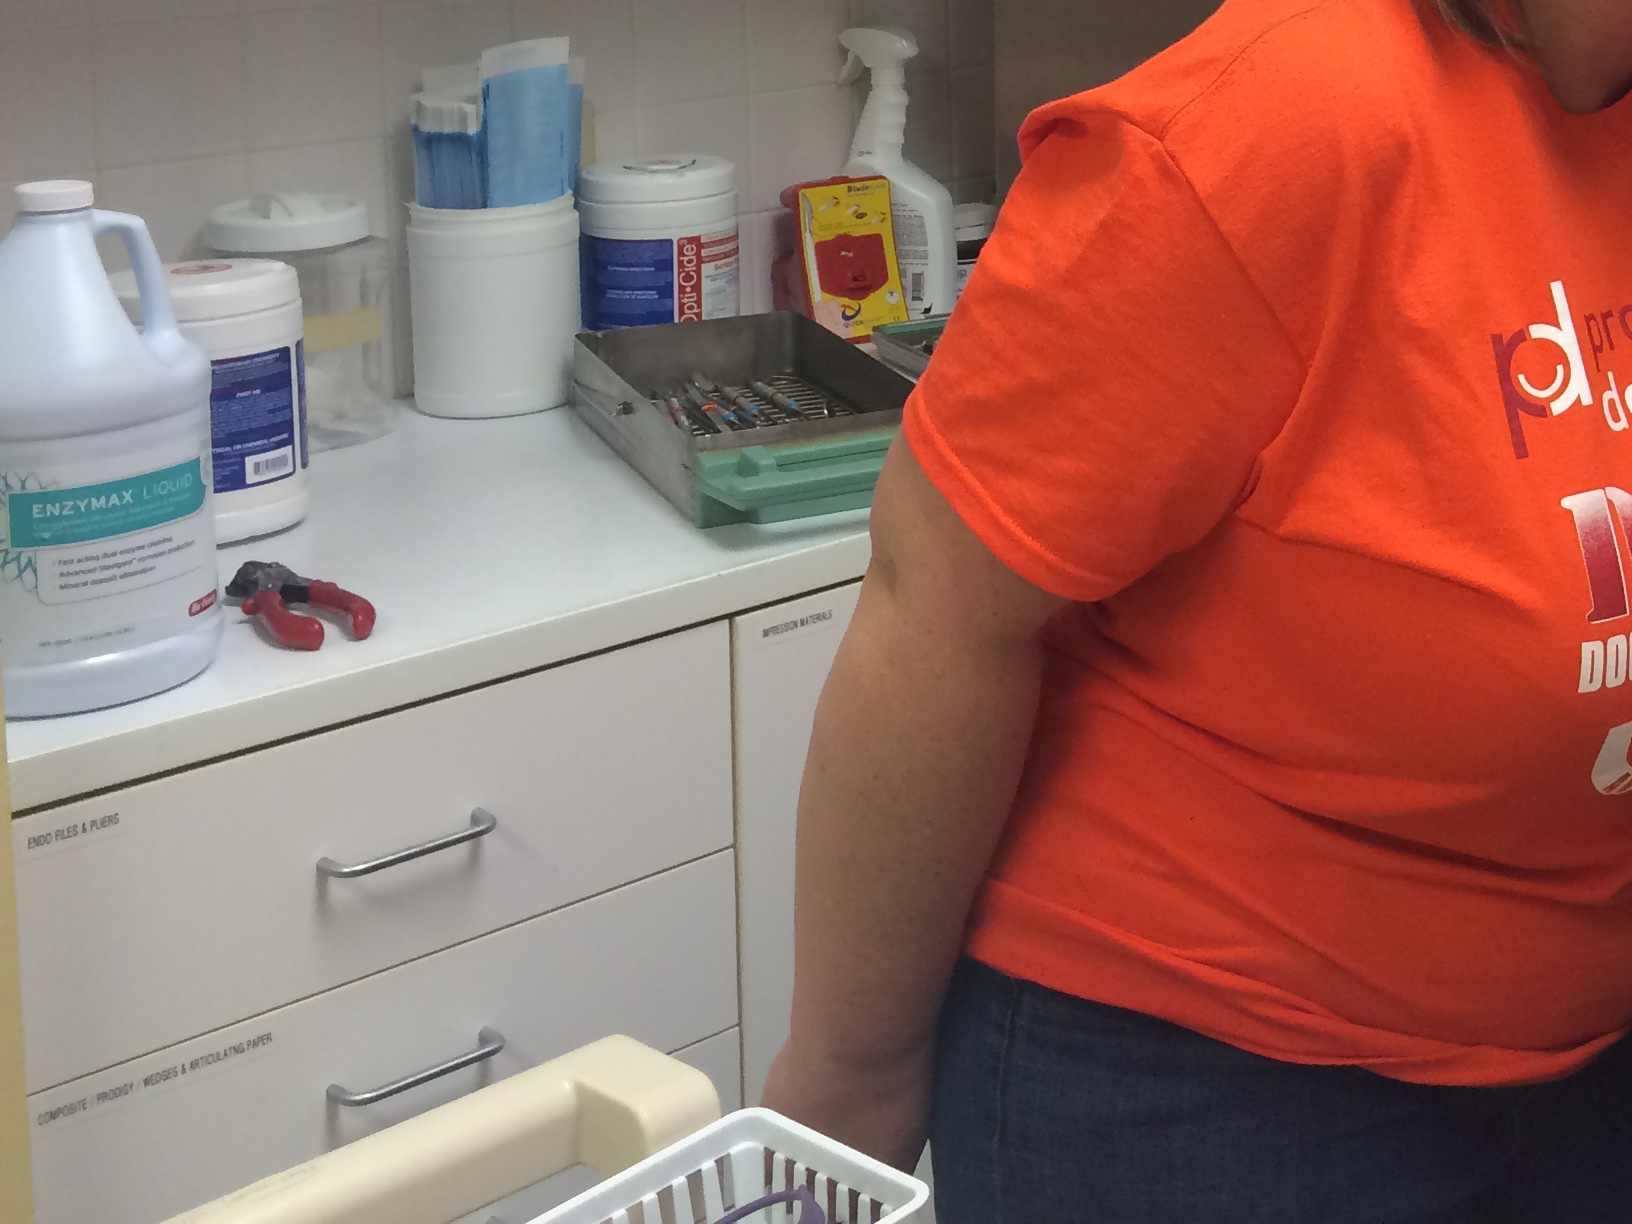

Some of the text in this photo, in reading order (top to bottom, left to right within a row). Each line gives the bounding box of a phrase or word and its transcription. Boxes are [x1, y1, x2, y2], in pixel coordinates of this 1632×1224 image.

[32, 473, 193, 519] ENZYMAX LIQUID
[28, 812, 120, 851] ENDO FILES & PLIERS
[38, 1098, 88, 1126] COMPOSITE
[96, 1082, 134, 1105] PRODIGY
[143, 1065, 179, 1088] WEDGES
[246, 1032, 273, 1051] PAPER
